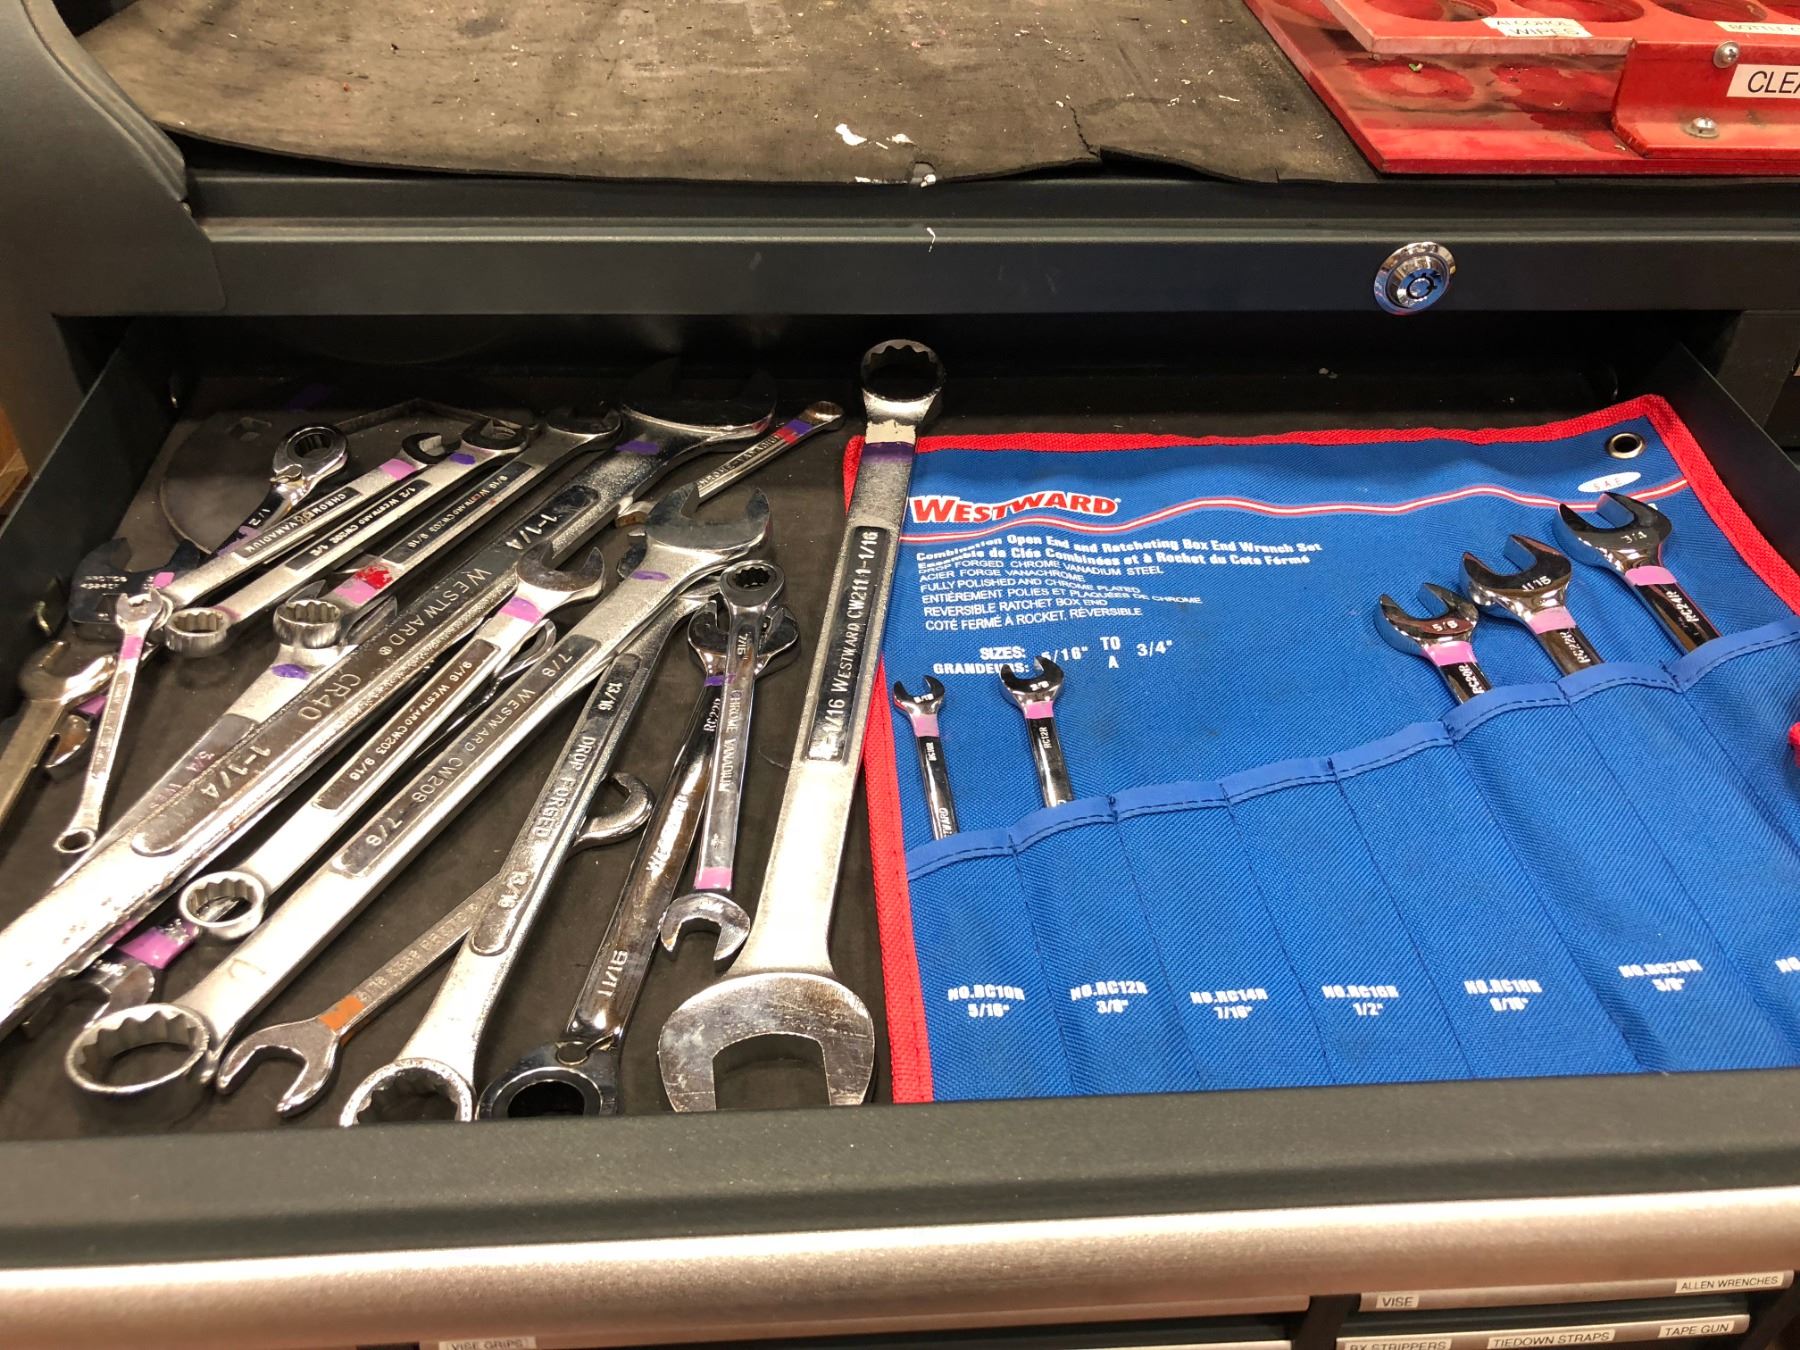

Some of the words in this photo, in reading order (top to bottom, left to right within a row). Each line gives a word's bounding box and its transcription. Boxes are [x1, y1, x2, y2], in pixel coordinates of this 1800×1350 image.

[1747, 71, 1800, 94] CLE
[910, 491, 1118, 522] WESTWARD
[505, 513, 558, 550] 1-1/4
[855, 531, 879, 575] 1-1/16
[916, 537, 1003, 562] Combination
[1007, 534, 1043, 547] Open
[1046, 536, 1070, 549] End
[1074, 542, 1098, 554] and
[1102, 538, 1180, 554] Ratcheting
[1182, 537, 1210, 551] Box
[1211, 539, 1237, 552] End
[1239, 541, 1294, 554] Wrench
[1297, 542, 1323, 553] Set
[989, 547, 1007, 558] de
[1011, 547, 1042, 559] Clés
[1046, 548, 1120, 567] Combinées
[1123, 554, 1140, 566] et
[1143, 552, 1153, 564] à
[1209, 553, 1227, 565] du
[919, 570, 956, 583] ACIER
[959, 568, 1002, 577] FORGE
[955, 560, 1005, 569] FORGED
[1010, 560, 1061, 569] CHROME
[1063, 562, 1122, 577] VANADIUM
[1126, 565, 1165, 576] STEEL
[846, 578, 870, 619] CW211
[920, 580, 955, 593] FULLY
[957, 578, 1016, 590] POLISHED
[1017, 577, 1043, 586] AND
[1045, 578, 1094, 590] CHROME
[1096, 585, 1141, 594] PLATED
[922, 590, 1003, 605] ENTIÈREMENT
[1007, 587, 1050, 598] POLIES
[1052, 587, 1066, 596] ET
[1151, 594, 1203, 604] CHROME
[389, 567, 492, 647] WESTWARD
[923, 602, 997, 617] REVERSIBLE
[999, 599, 1052, 612] RATCHET
[1056, 599, 1081, 607] BOX
[925, 619, 958, 631] COTÉ
[961, 616, 1002, 630] FERMÉ
[1004, 614, 1015, 627] À
[1070, 606, 1143, 618] RÉVERSIBLE
[831, 622, 861, 693] WESTWARD
[979, 645, 1026, 661] SIZES:
[1099, 635, 1121, 651] TO
[1136, 640, 1174, 657] 3/4"
[449, 660, 474, 684] 9/16
[541, 649, 573, 678] 7/8
[933, 662, 1030, 675] GRANDEUS:
[1107, 655, 1119, 669] A
[405, 683, 451, 727] WESTWARD
[464, 687, 536, 754] WESTWARD
[375, 724, 409, 756] CW203
[568, 735, 597, 772] DROP
[200, 744, 272, 800] 1-1/4
[349, 756, 377, 782] 9/16
[531, 776, 579, 839] FORGED
[365, 810, 404, 848] 7/8
[1680, 1280, 1715, 1290] ALLEN
[1717, 1275, 1779, 1288] WRENCHES
[1381, 1296, 1414, 1308] VISE
[1493, 1335, 1554, 1348] TIEDOWN
[1557, 1331, 1610, 1344] STRAPS
[1665, 1325, 1696, 1336] TAPE
[1700, 1322, 1730, 1334] GUN
